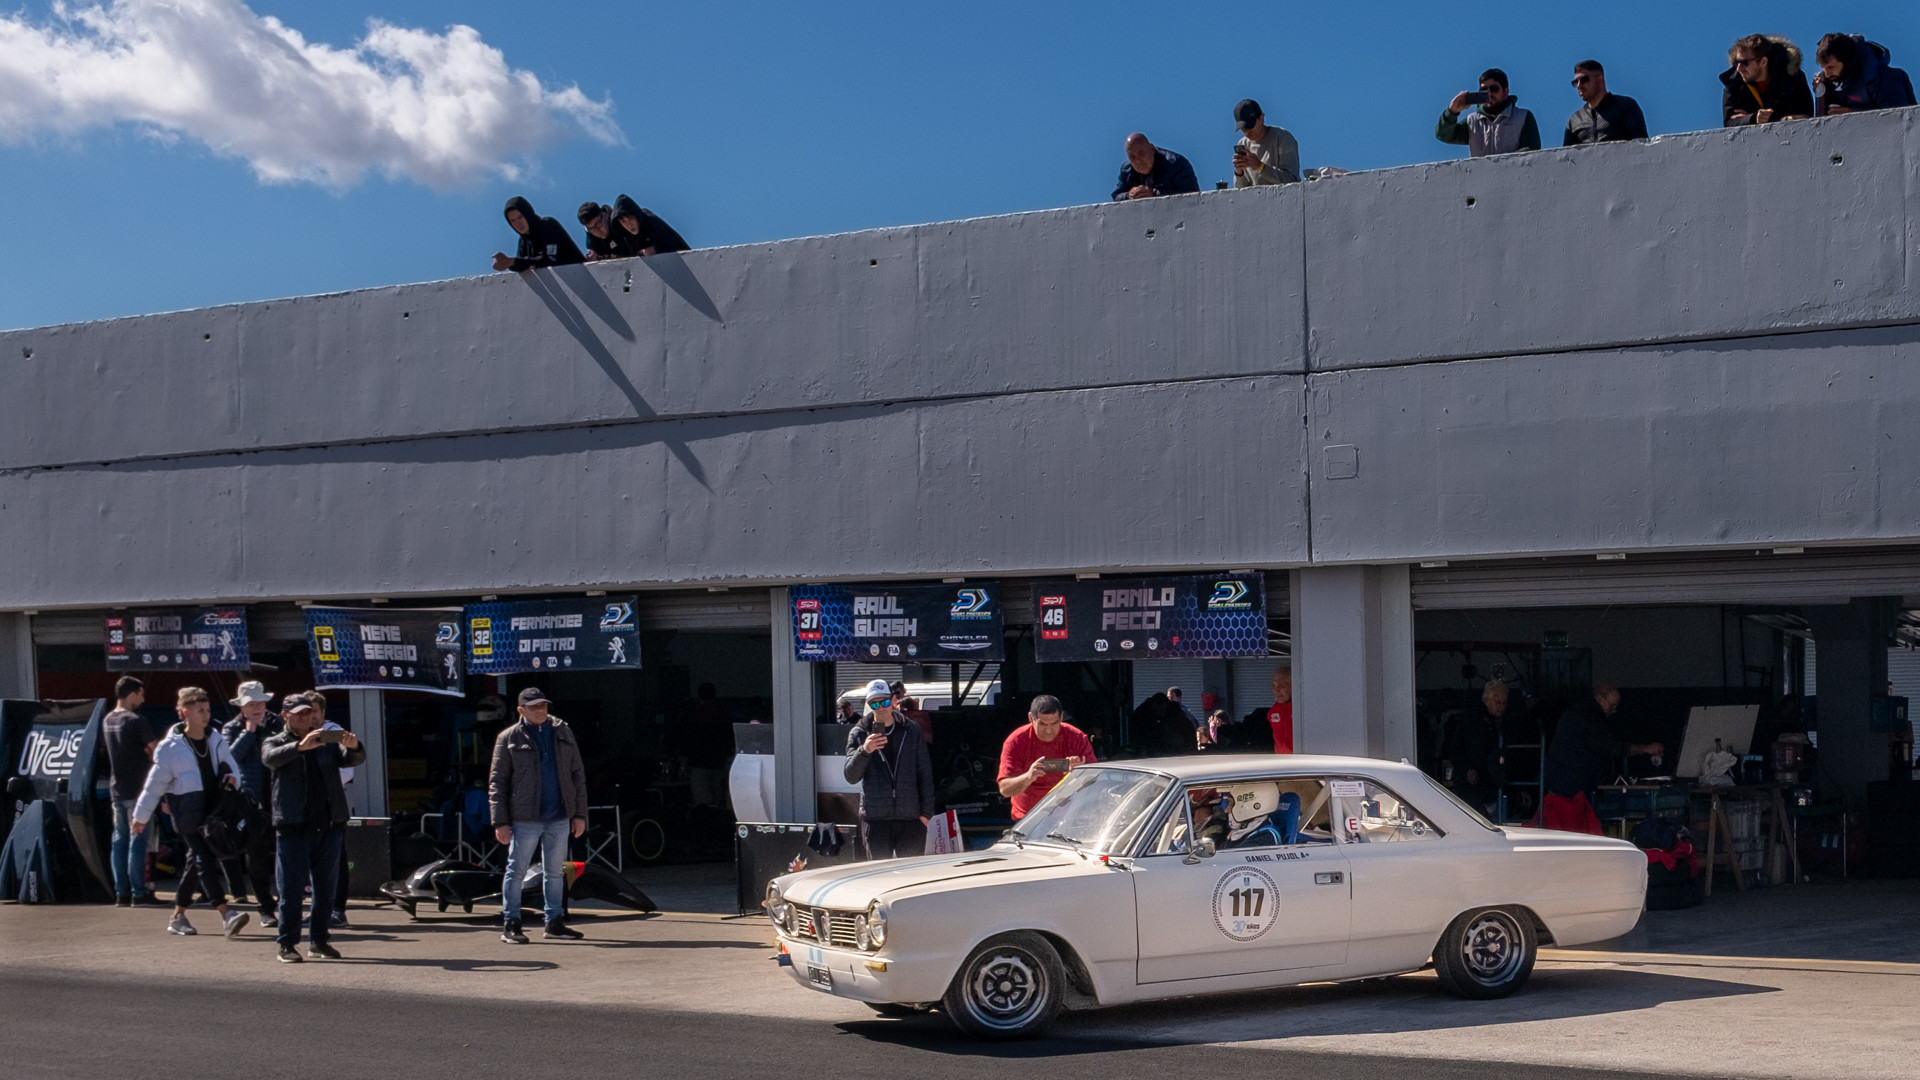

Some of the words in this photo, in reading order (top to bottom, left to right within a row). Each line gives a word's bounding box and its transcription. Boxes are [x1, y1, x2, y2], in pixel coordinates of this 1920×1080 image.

[854, 592, 903, 615] RAÚL
[1103, 587, 1175, 608] DANILO
[800, 612, 819, 629] 31
[1043, 608, 1064, 626] 46
[1102, 611, 1161, 631] PECCI
[854, 618, 917, 637] GUASH
[474, 630, 490, 645] 32
[532, 637, 576, 652] PIETRO
[364, 643, 417, 661] SERGIO
[1349, 818, 1359, 831] E
[1245, 854, 1274, 863] DANIEL
[1275, 852, 1300, 861] PUJOL
[1229, 888, 1265, 917] 117
